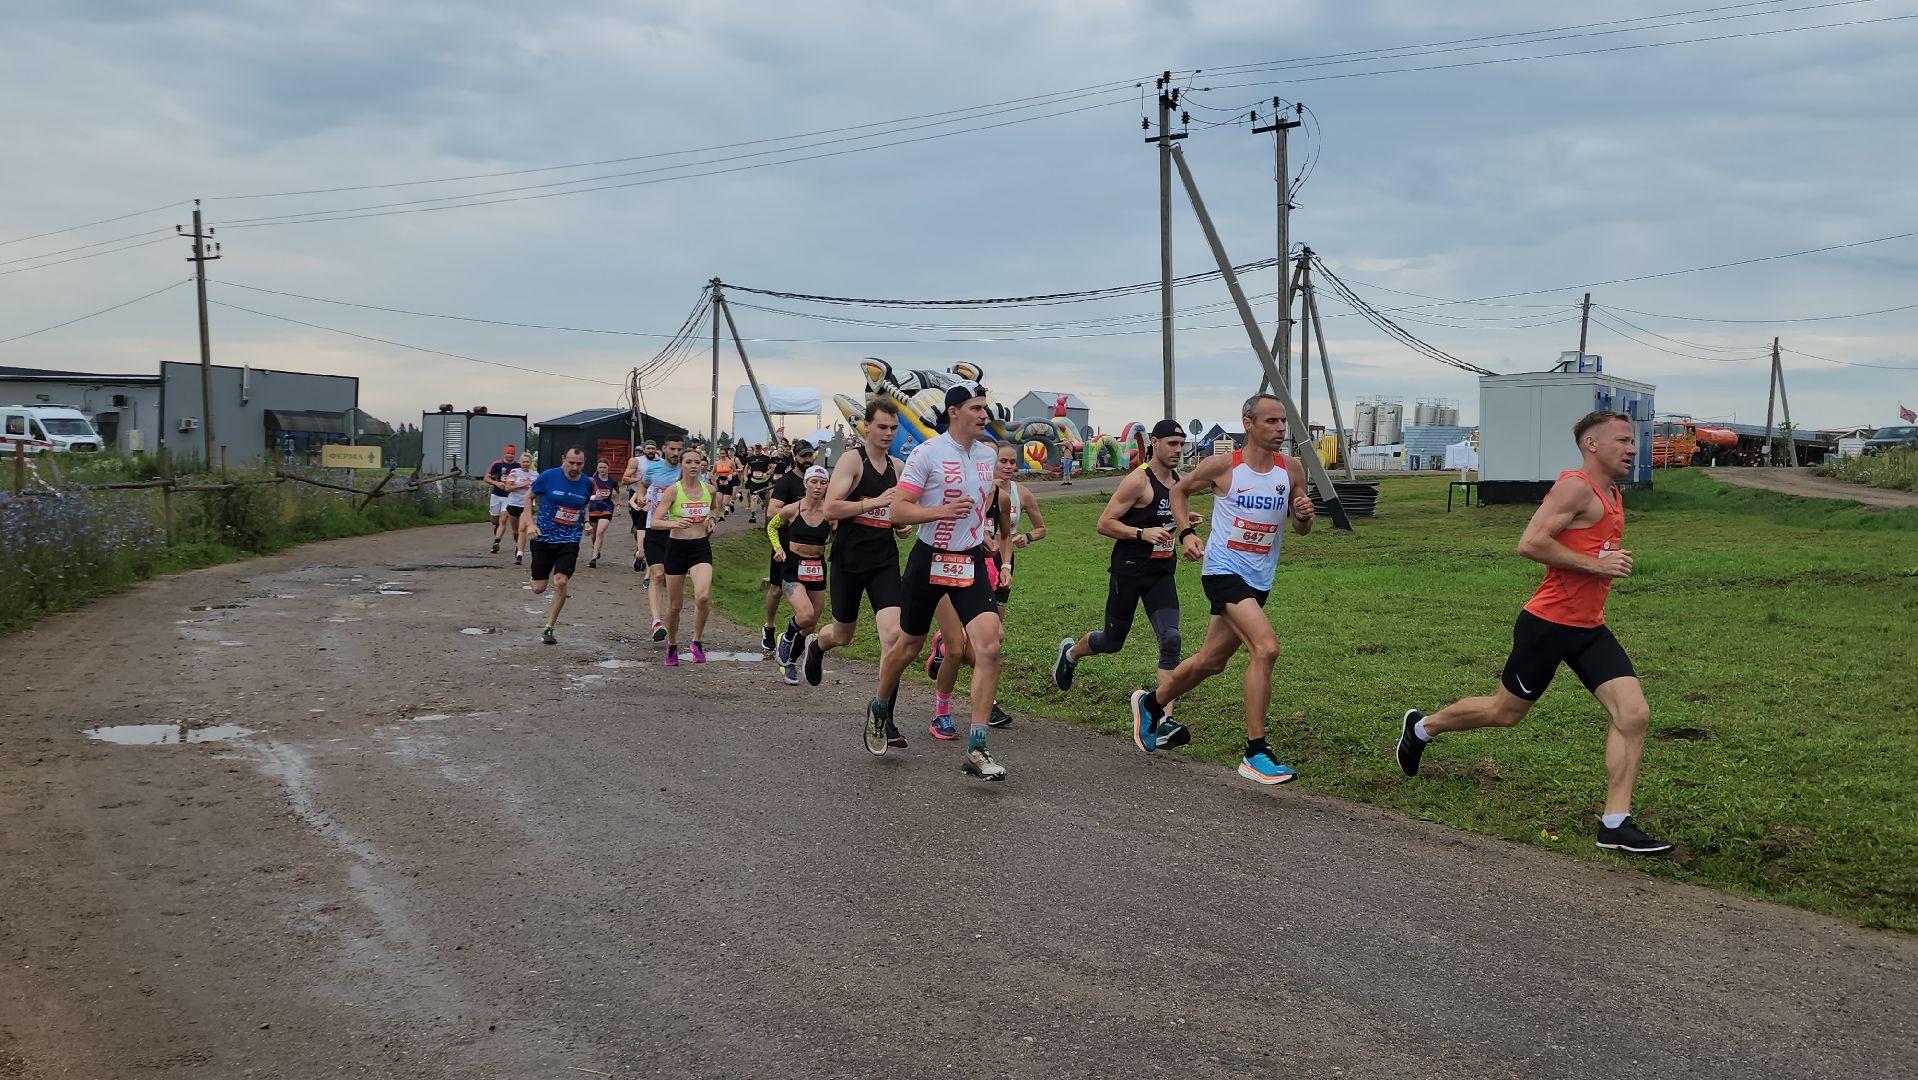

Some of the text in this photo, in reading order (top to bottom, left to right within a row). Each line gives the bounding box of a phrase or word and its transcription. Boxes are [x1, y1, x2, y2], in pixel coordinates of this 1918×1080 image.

[942, 461, 962, 484] SKI
[1236, 495, 1284, 510] RUSSIA
[1243, 531, 1265, 542] 647
[943, 563, 964, 575] 542
